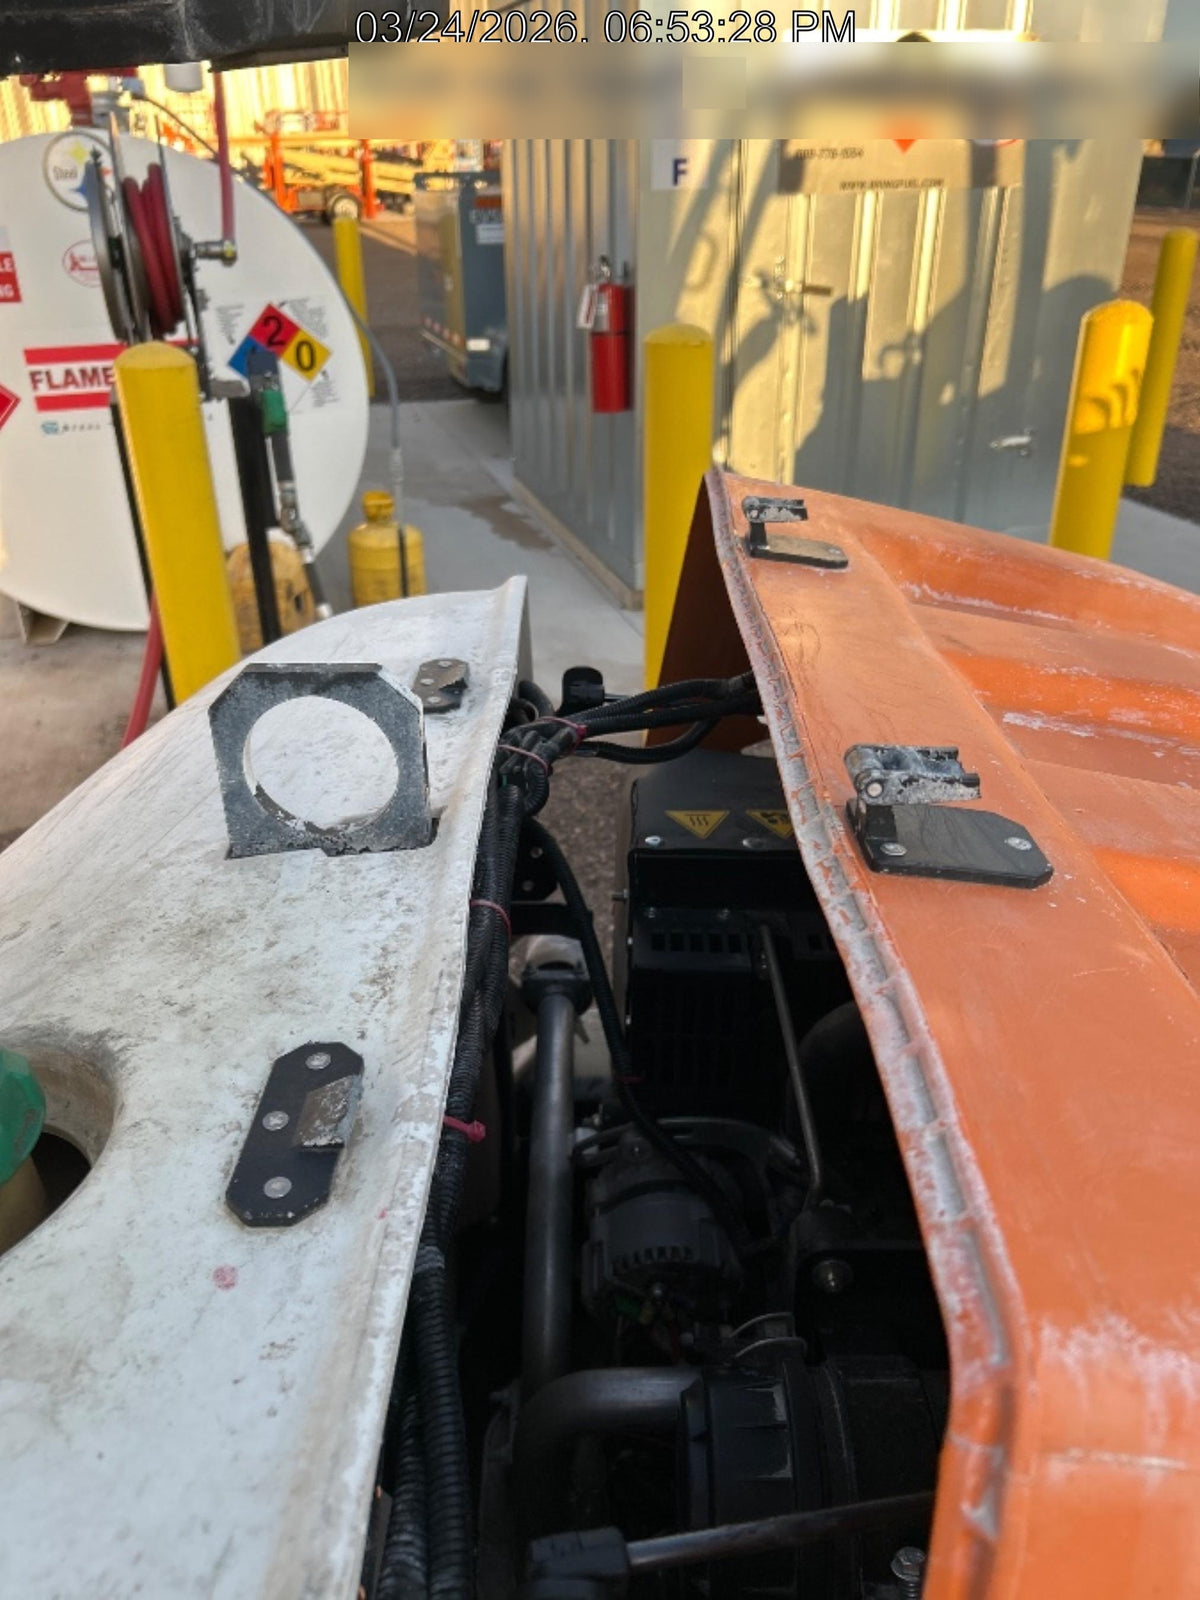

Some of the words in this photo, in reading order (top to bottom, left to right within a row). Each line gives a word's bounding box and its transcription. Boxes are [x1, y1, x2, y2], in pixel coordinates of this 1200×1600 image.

[672, 157, 688, 187] F
[262, 315, 287, 347] 2
[295, 340, 316, 372] 0
